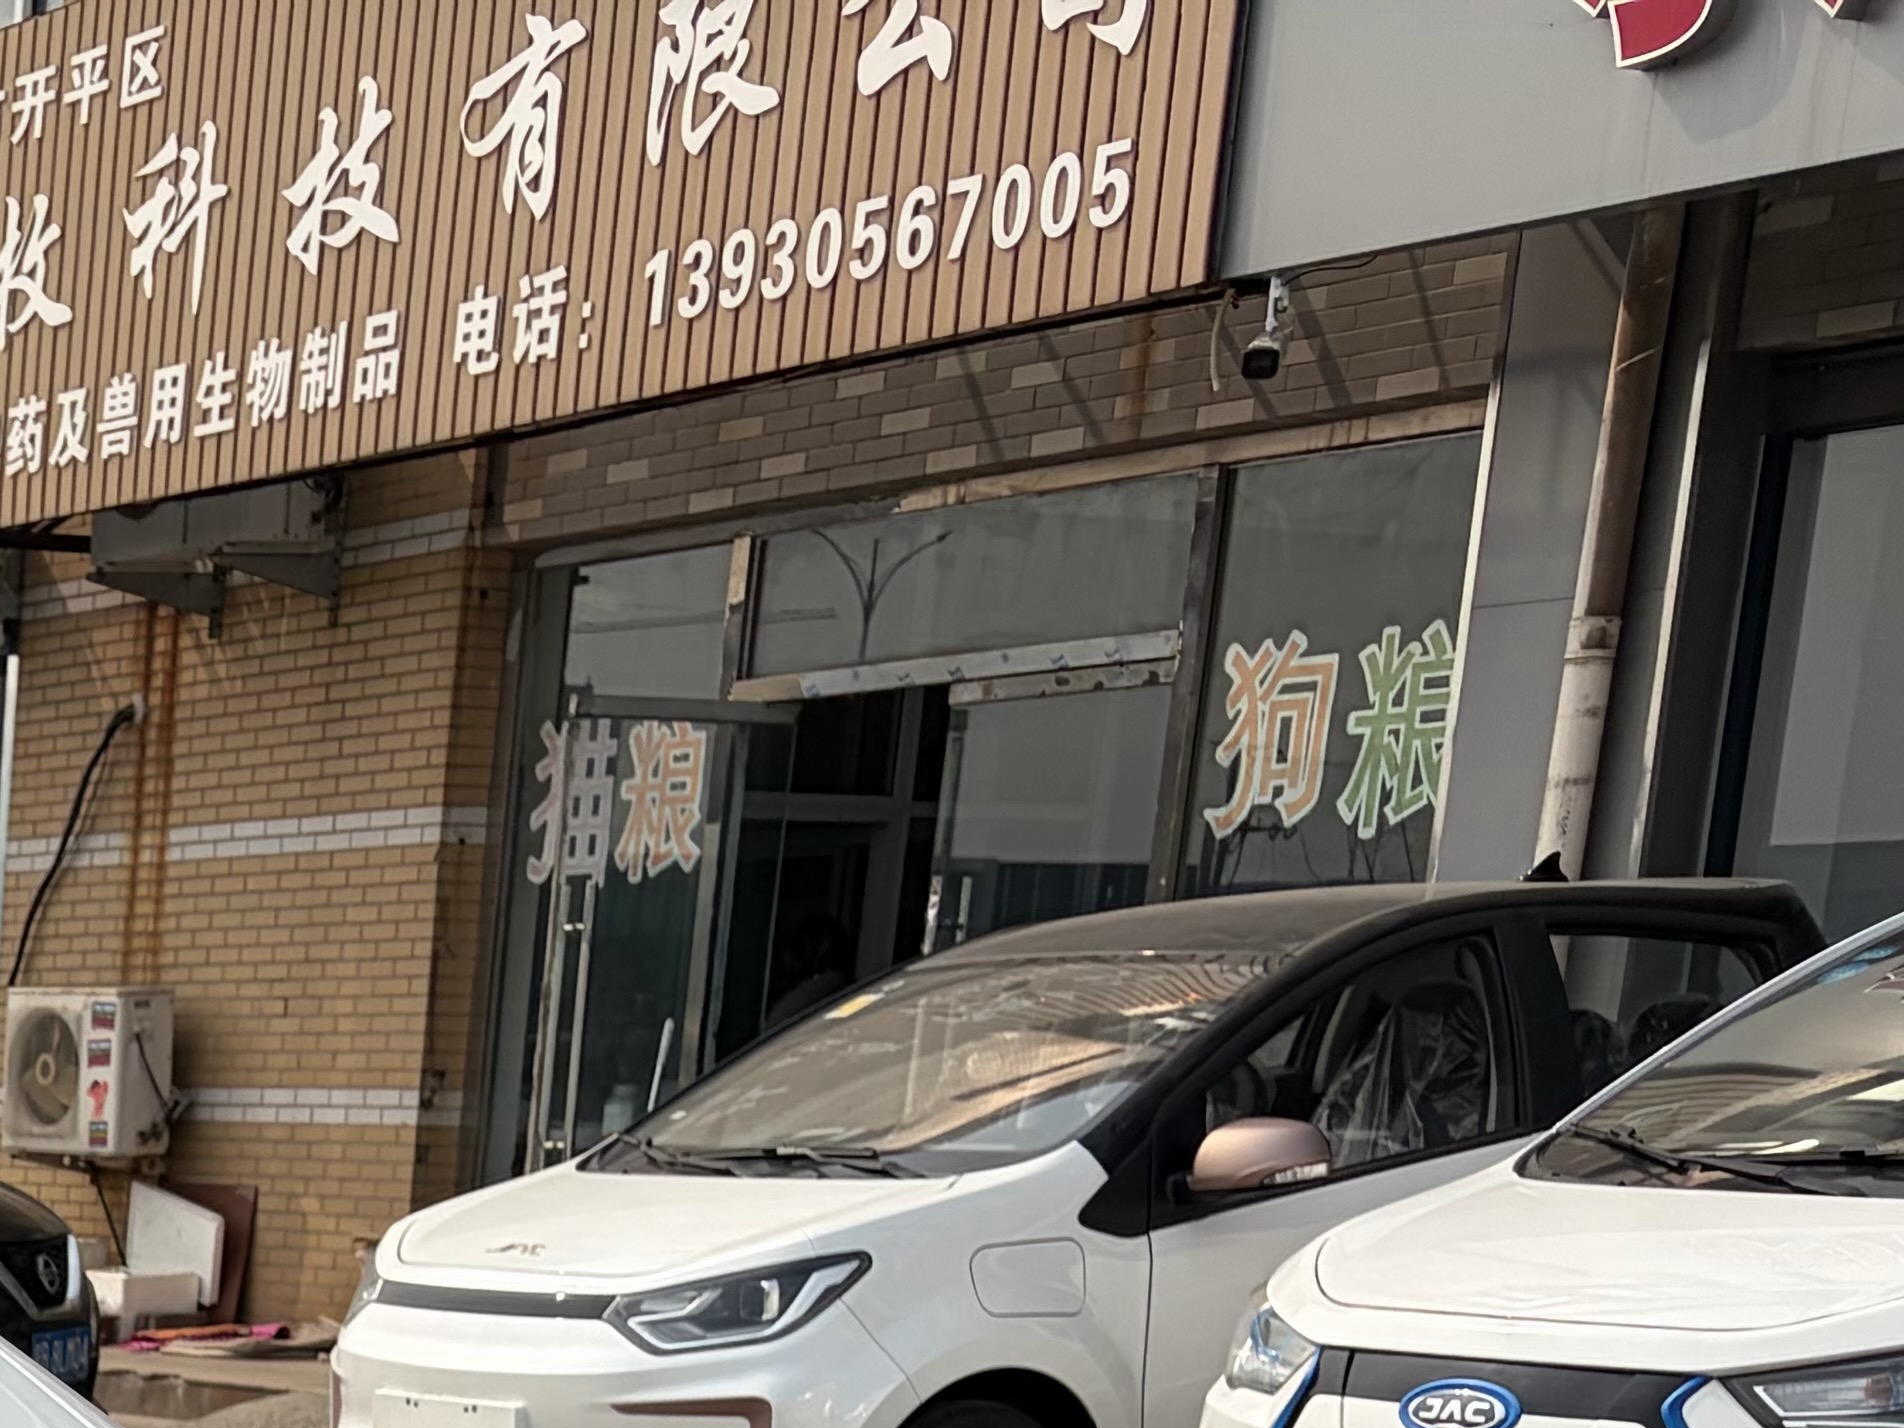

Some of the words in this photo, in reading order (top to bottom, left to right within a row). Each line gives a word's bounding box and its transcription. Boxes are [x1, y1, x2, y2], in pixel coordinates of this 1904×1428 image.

[643, 137, 1135, 327] 13930567005
[526, 717, 708, 889] 猫粮
[1203, 618, 1457, 840] 狗粮
[1418, 1397, 1491, 1424] JAC
